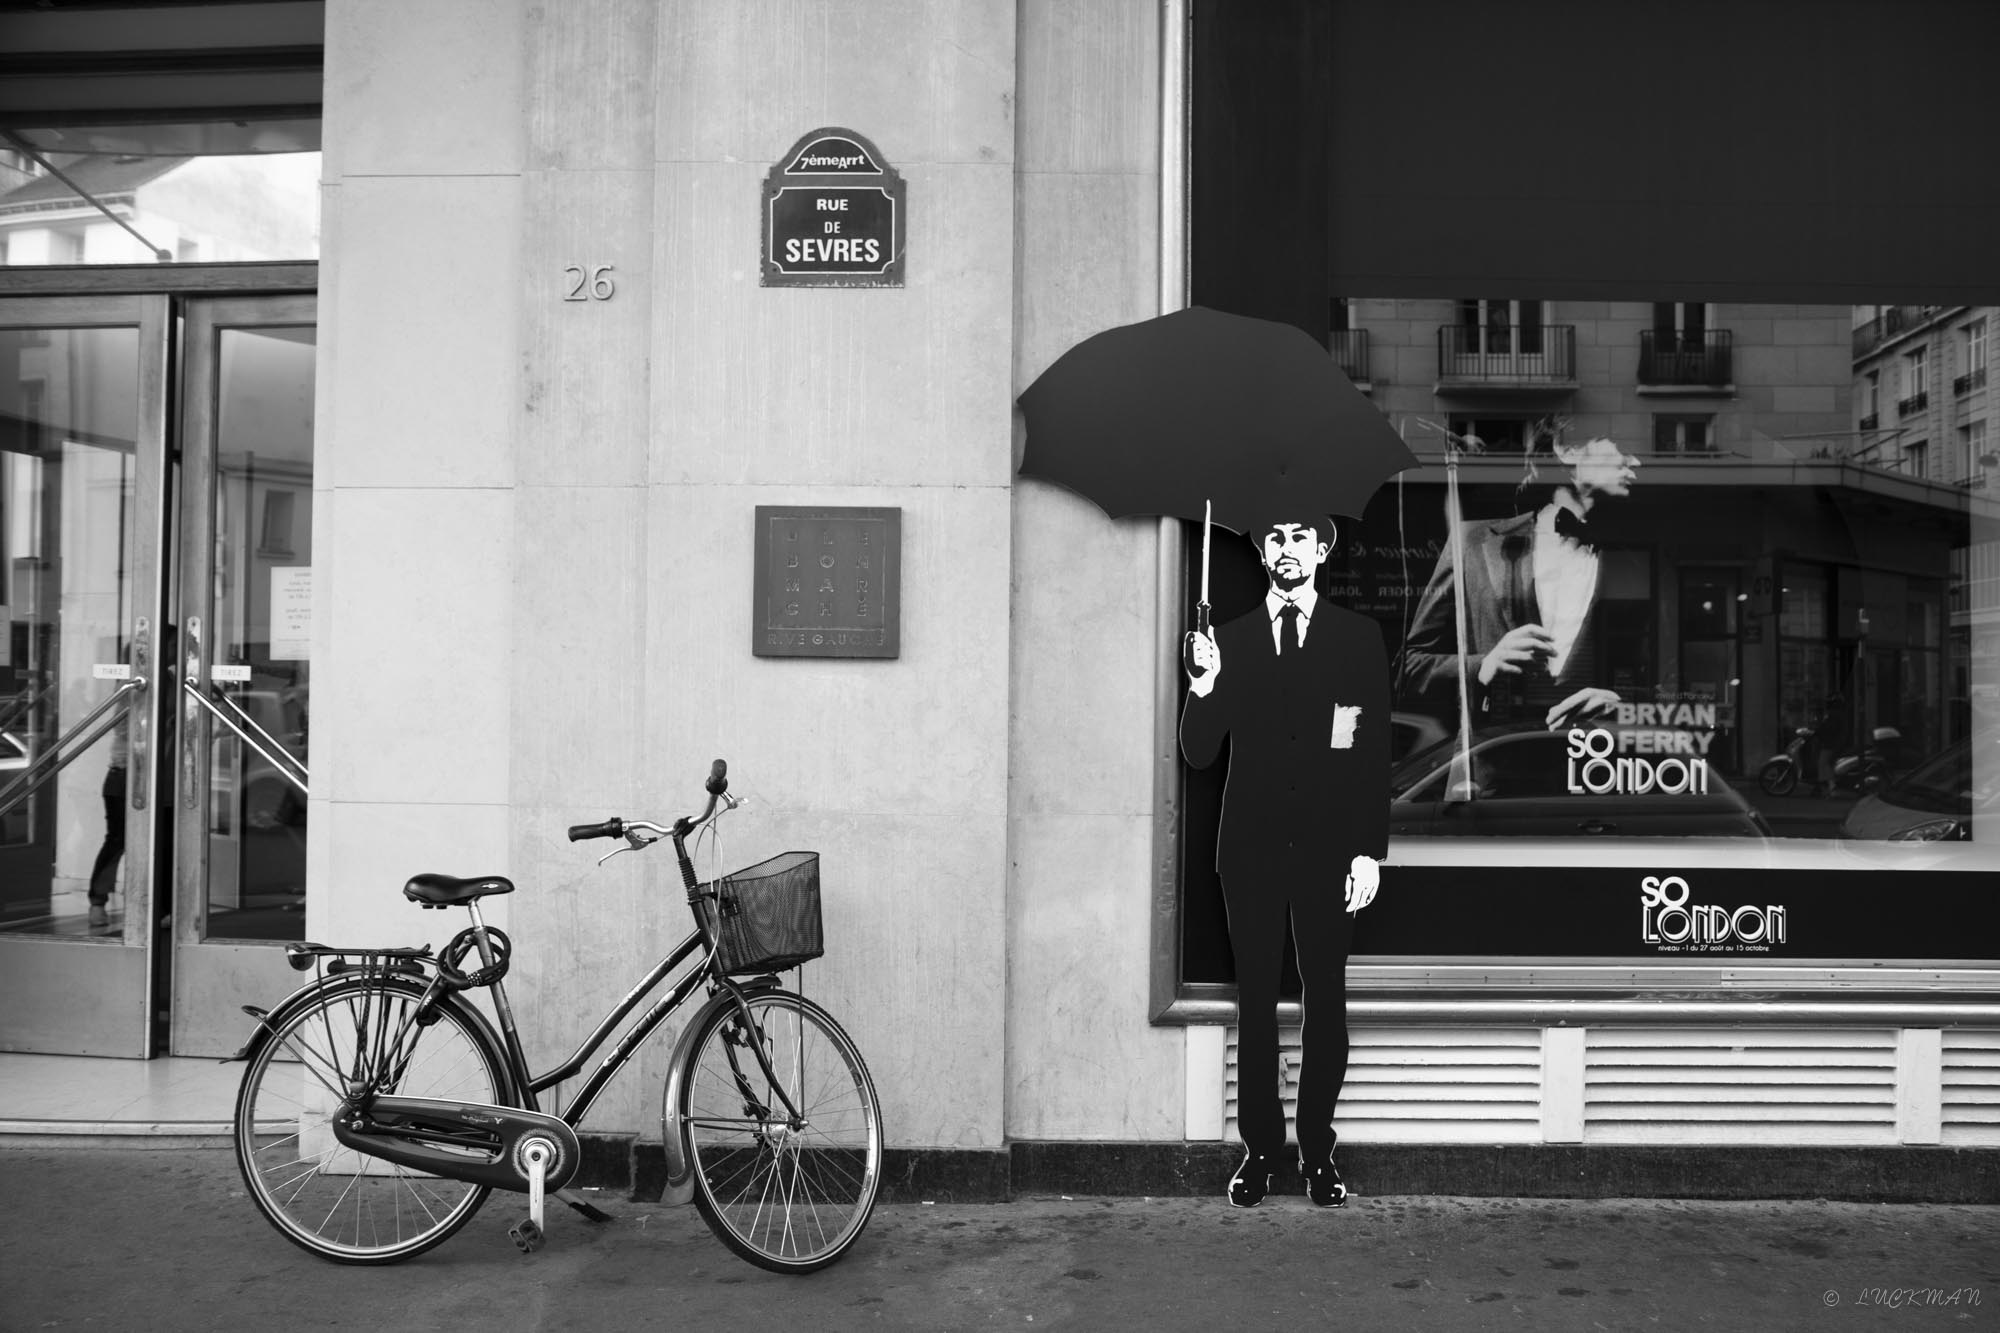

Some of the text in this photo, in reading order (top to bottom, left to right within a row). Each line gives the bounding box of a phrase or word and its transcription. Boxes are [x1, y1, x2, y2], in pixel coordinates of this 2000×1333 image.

[816, 199, 849, 211] RUE
[824, 221, 841, 234] DE
[785, 238, 880, 263] SEVRES
[563, 264, 616, 303] 26
[1616, 703, 1716, 726] BRYAN
[1567, 728, 1615, 758] SO
[1617, 731, 1715, 754] FERRY
[1567, 757, 1708, 795] LONDON
[1640, 876, 1690, 908] SO
[1642, 905, 1787, 944] LONDON
[1657, 944, 1680, 952] niveau
[1690, 944, 1699, 952] du
[1699, 944, 1708, 952] 27
[1709, 944, 1724, 952] août
[1725, 944, 1734, 952] au
[1736, 944, 1744, 952] 15
[1745, 944, 1769, 952] octobre
